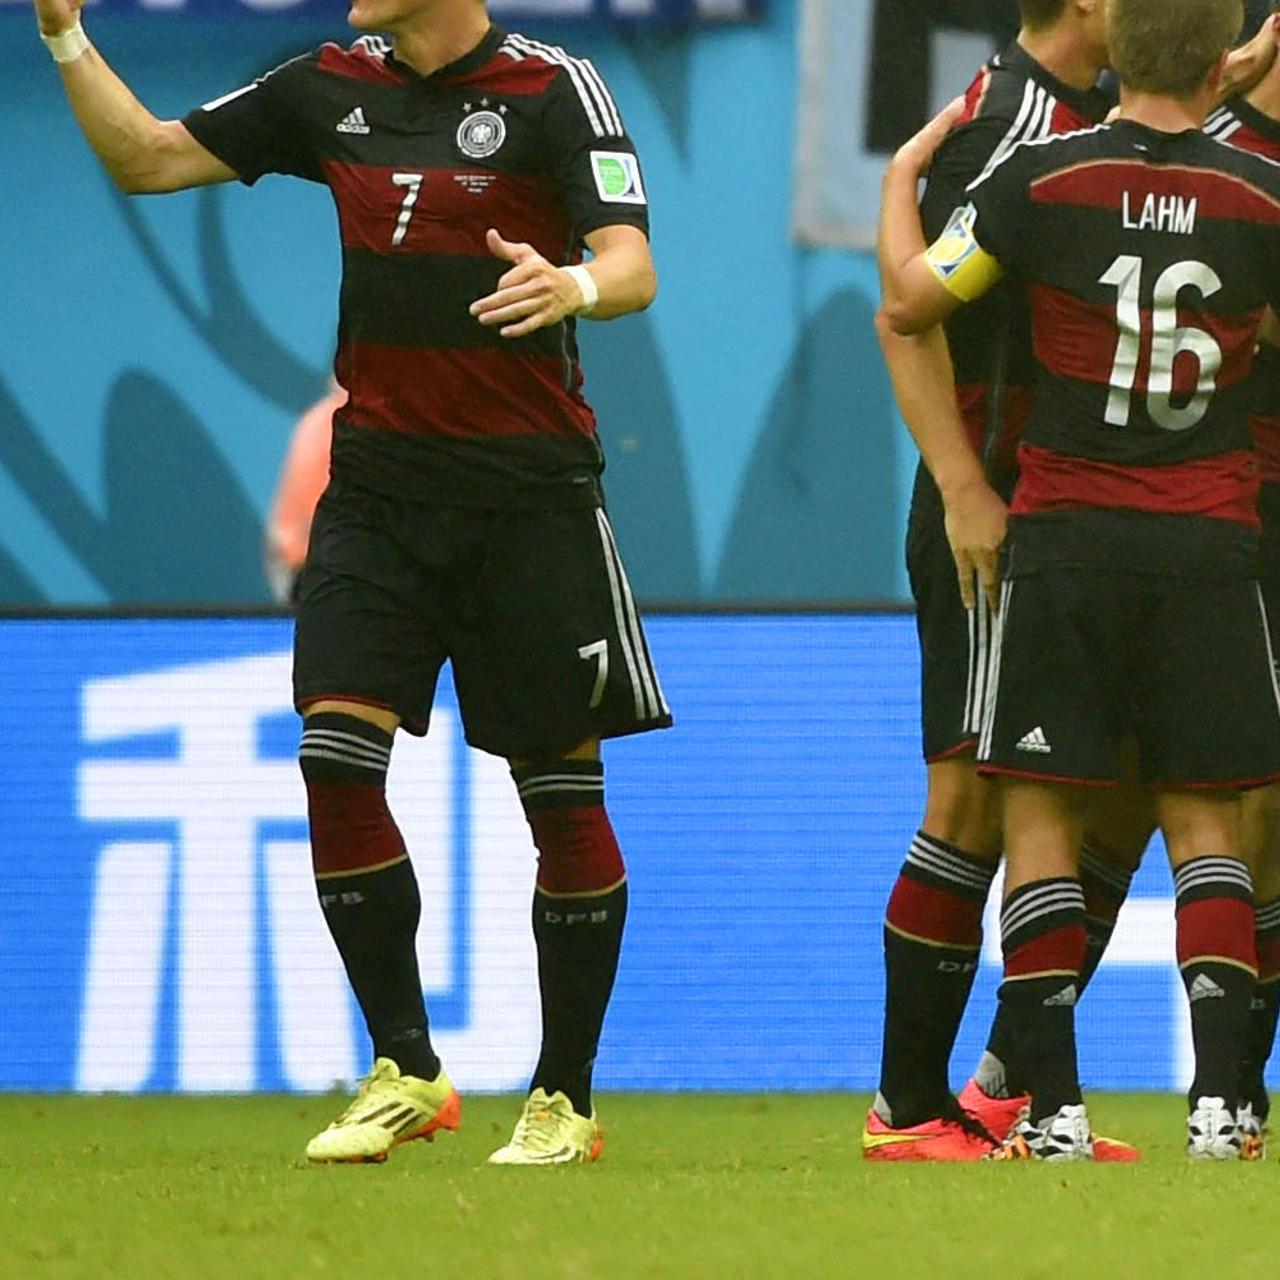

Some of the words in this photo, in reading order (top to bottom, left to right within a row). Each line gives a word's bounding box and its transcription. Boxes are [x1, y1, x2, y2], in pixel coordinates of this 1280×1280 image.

[391, 172, 424, 246] 7
[1121, 191, 1197, 236] LAHM
[1099, 255, 1223, 431] 16
[577, 639, 608, 708] 7
